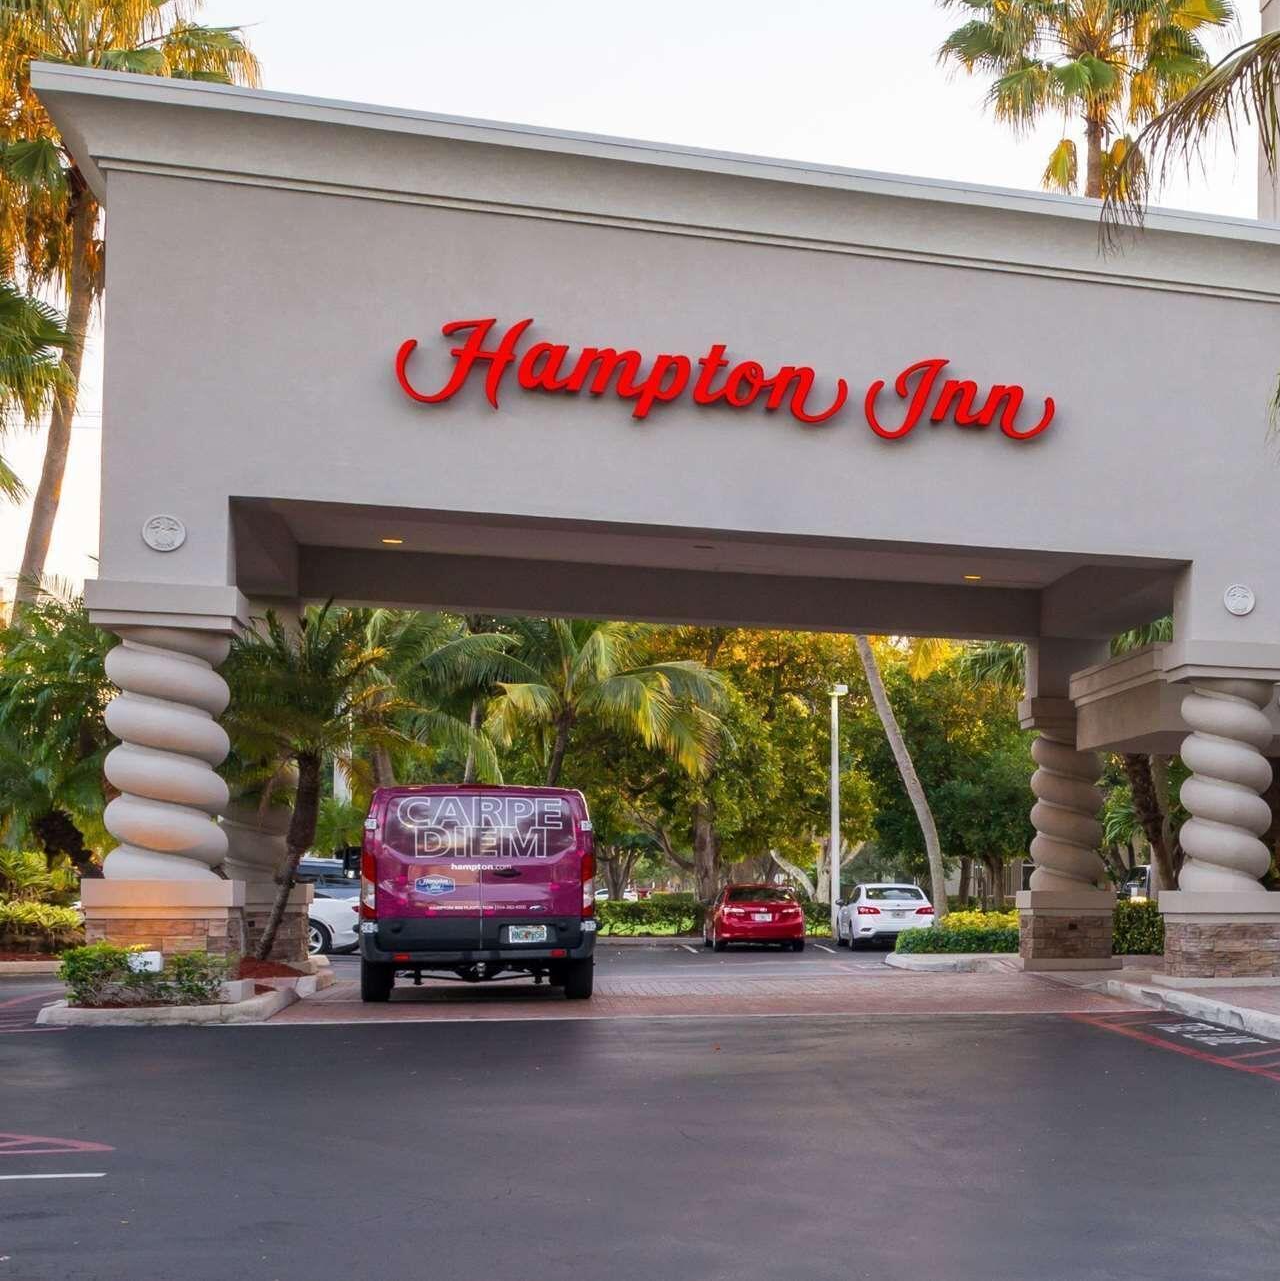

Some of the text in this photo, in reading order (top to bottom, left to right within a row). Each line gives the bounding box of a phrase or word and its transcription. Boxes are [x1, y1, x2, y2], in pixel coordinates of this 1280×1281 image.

[396, 318, 1055, 440] Hampton Inn
[397, 797, 563, 831] CARPE
[414, 826, 548, 858] DIEM
[451, 863, 512, 871] hampton.com
